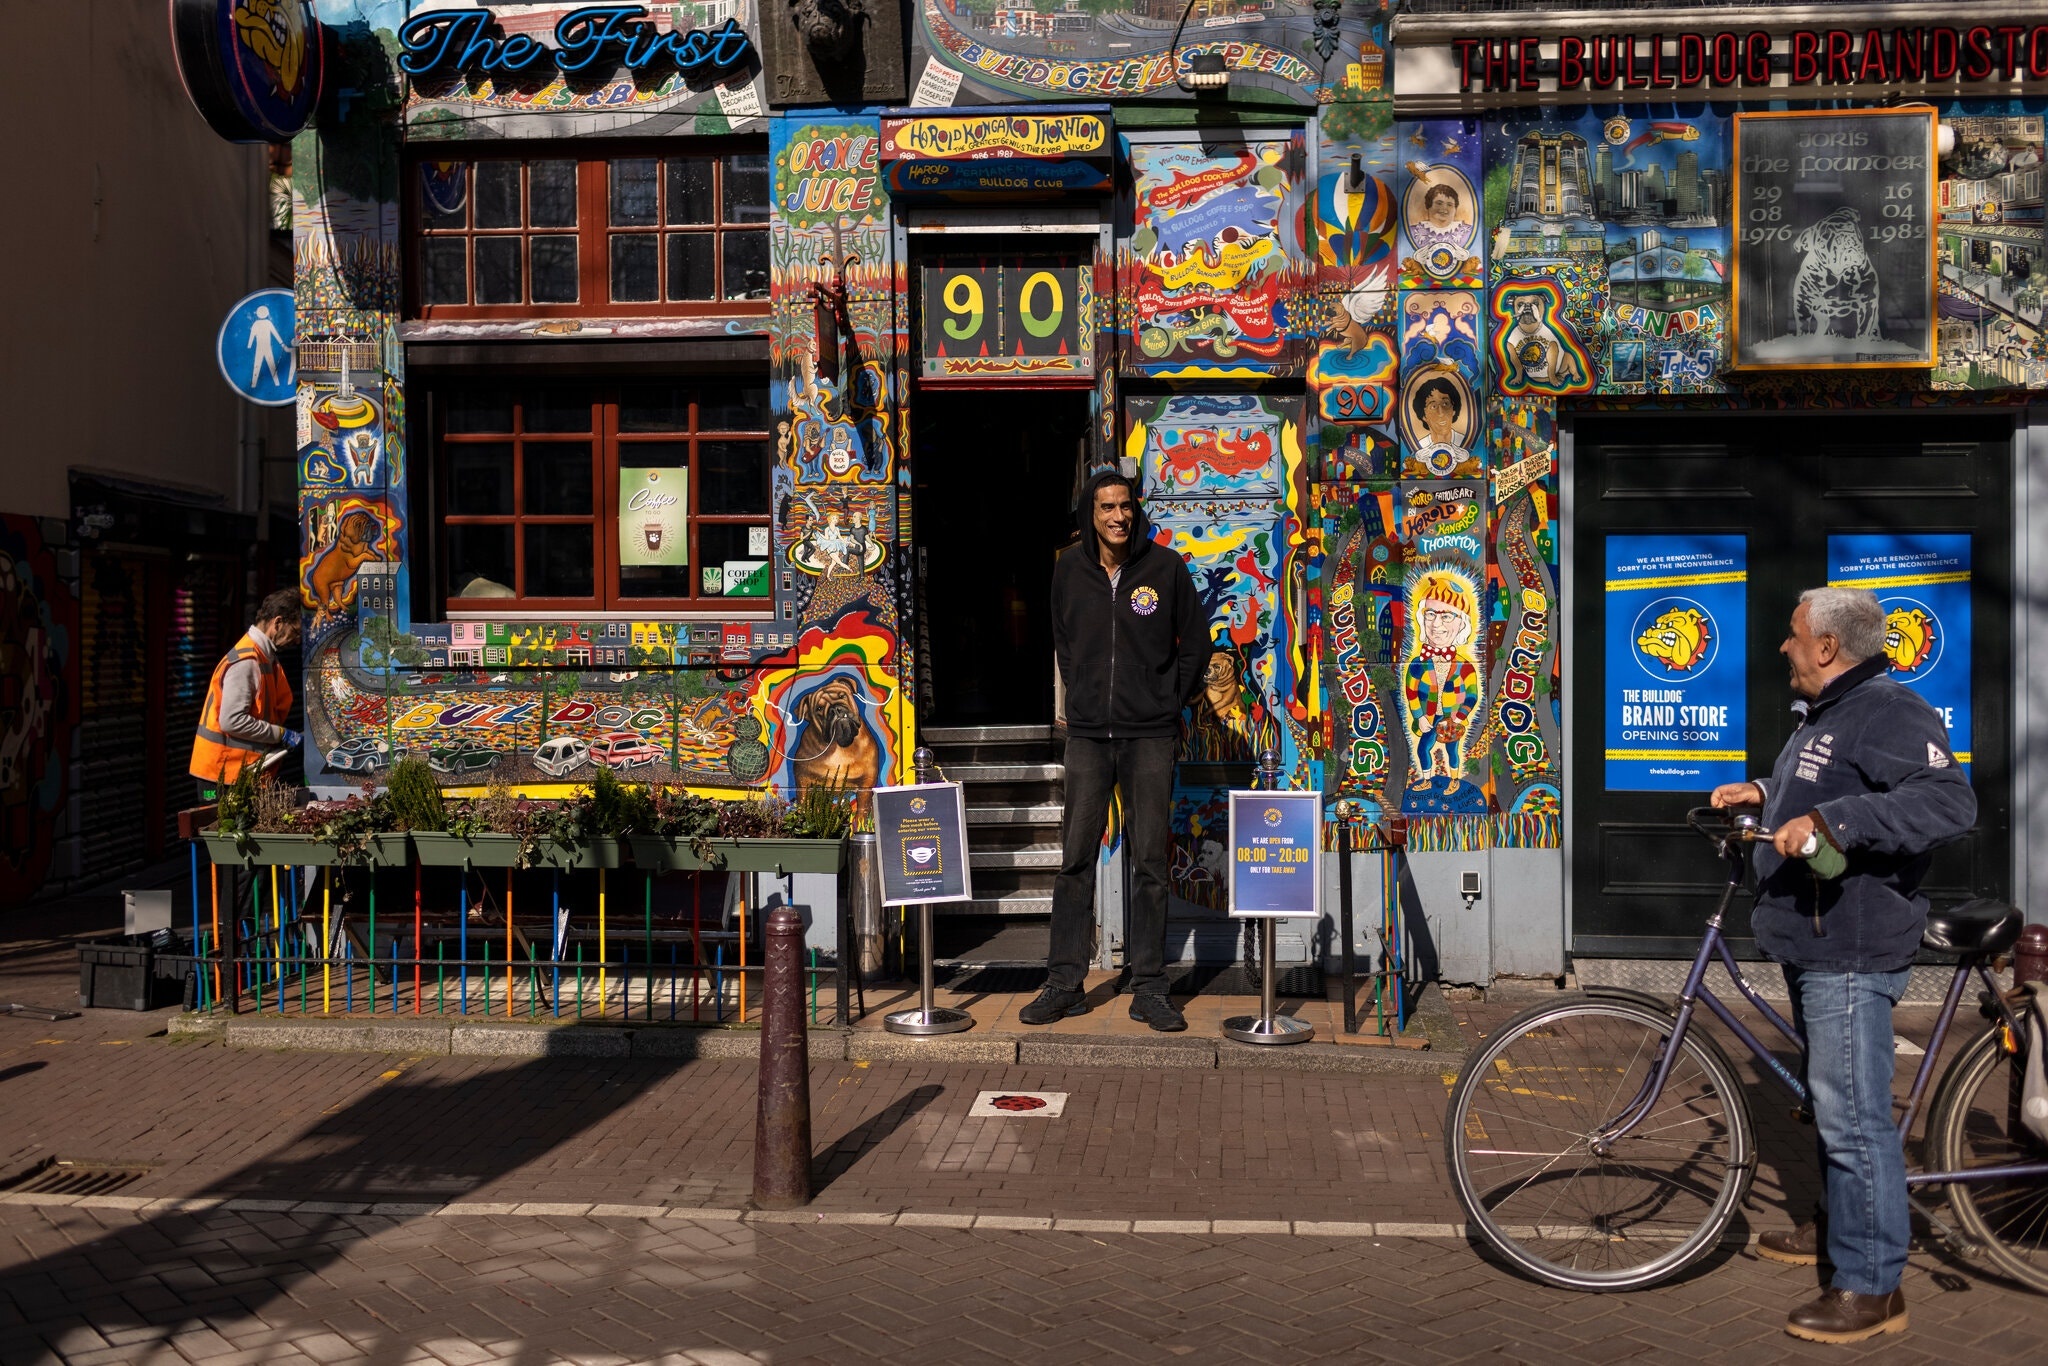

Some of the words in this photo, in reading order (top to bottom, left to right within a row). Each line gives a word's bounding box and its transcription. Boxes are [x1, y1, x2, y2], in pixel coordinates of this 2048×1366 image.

[402, 8, 544, 73] The
[555, 6, 747, 72] First
[958, 44, 1090, 90] BULLDOG
[1455, 36, 1540, 91] THE
[1559, 31, 1771, 87] BULLDOG
[722, 91, 756, 109] DECORATE
[1797, 130, 1869, 149] JORIS
[789, 135, 879, 174] ORANGE
[1175, 154, 1190, 164] OUR
[908, 164, 950, 180] HAROLD
[1741, 155, 1791, 174] the
[1797, 152, 1927, 178] founder
[979, 177, 1029, 188] BULLDOG
[1034, 179, 1063, 188] CLUB
[1168, 176, 1201, 194] BULLDOG
[787, 177, 873, 213] JUICE
[1752, 186, 1783, 204] 29
[1884, 182, 1913, 200] 16
[1750, 206, 1783, 222] 08
[1882, 203, 1916, 222] 04
[1170, 213, 1205, 232] BULLDOG
[1740, 224, 1793, 245] 1976
[1170, 261, 1198, 281] BULLDOG
[1201, 317, 1221, 330] BIKE
[1616, 303, 1719, 339] CANADA
[1659, 350, 1698, 380] Take
[1695, 349, 1715, 381] 5
[1336, 384, 1379, 416] 90
[1409, 492, 1434, 506] WORLD
[1498, 478, 1526, 501] AUSSIE
[628, 488, 678, 511] Coffee
[1421, 535, 1480, 555] THORNTON
[1617, 565, 1641, 573] SORRY
[1674, 558, 1734, 568] INCONVENIENCE
[1666, 553, 1713, 562] RENOVATING
[1840, 565, 1863, 573] SORRY
[1898, 558, 1959, 568] INCONVENIENCE
[1889, 552, 1938, 561] RENOVATING
[727, 569, 766, 578] COFFEE
[733, 577, 760, 586] SHOP
[1138, 586, 1159, 601] BULLDOG
[1131, 602, 1158, 616] AMSTERDAM
[1330, 583, 1384, 775] BULLDOG
[1500, 587, 1547, 765] BULLDOG
[1623, 689, 1640, 703] THE
[1622, 705, 1675, 726] BRAND
[1679, 705, 1728, 727] STORE
[1622, 730, 1679, 741] OPENING
[1682, 731, 1719, 741] SOON
[1649, 768, 1700, 776] thebulldog.com
[1237, 847, 1267, 863] 08:00
[1279, 847, 1309, 863] 20:00
[1250, 866, 1261, 874] ONLY
[1262, 866, 1271, 874] FOR
[1271, 866, 1283, 874] TAKE
[1283, 866, 1296, 874] AWAY
